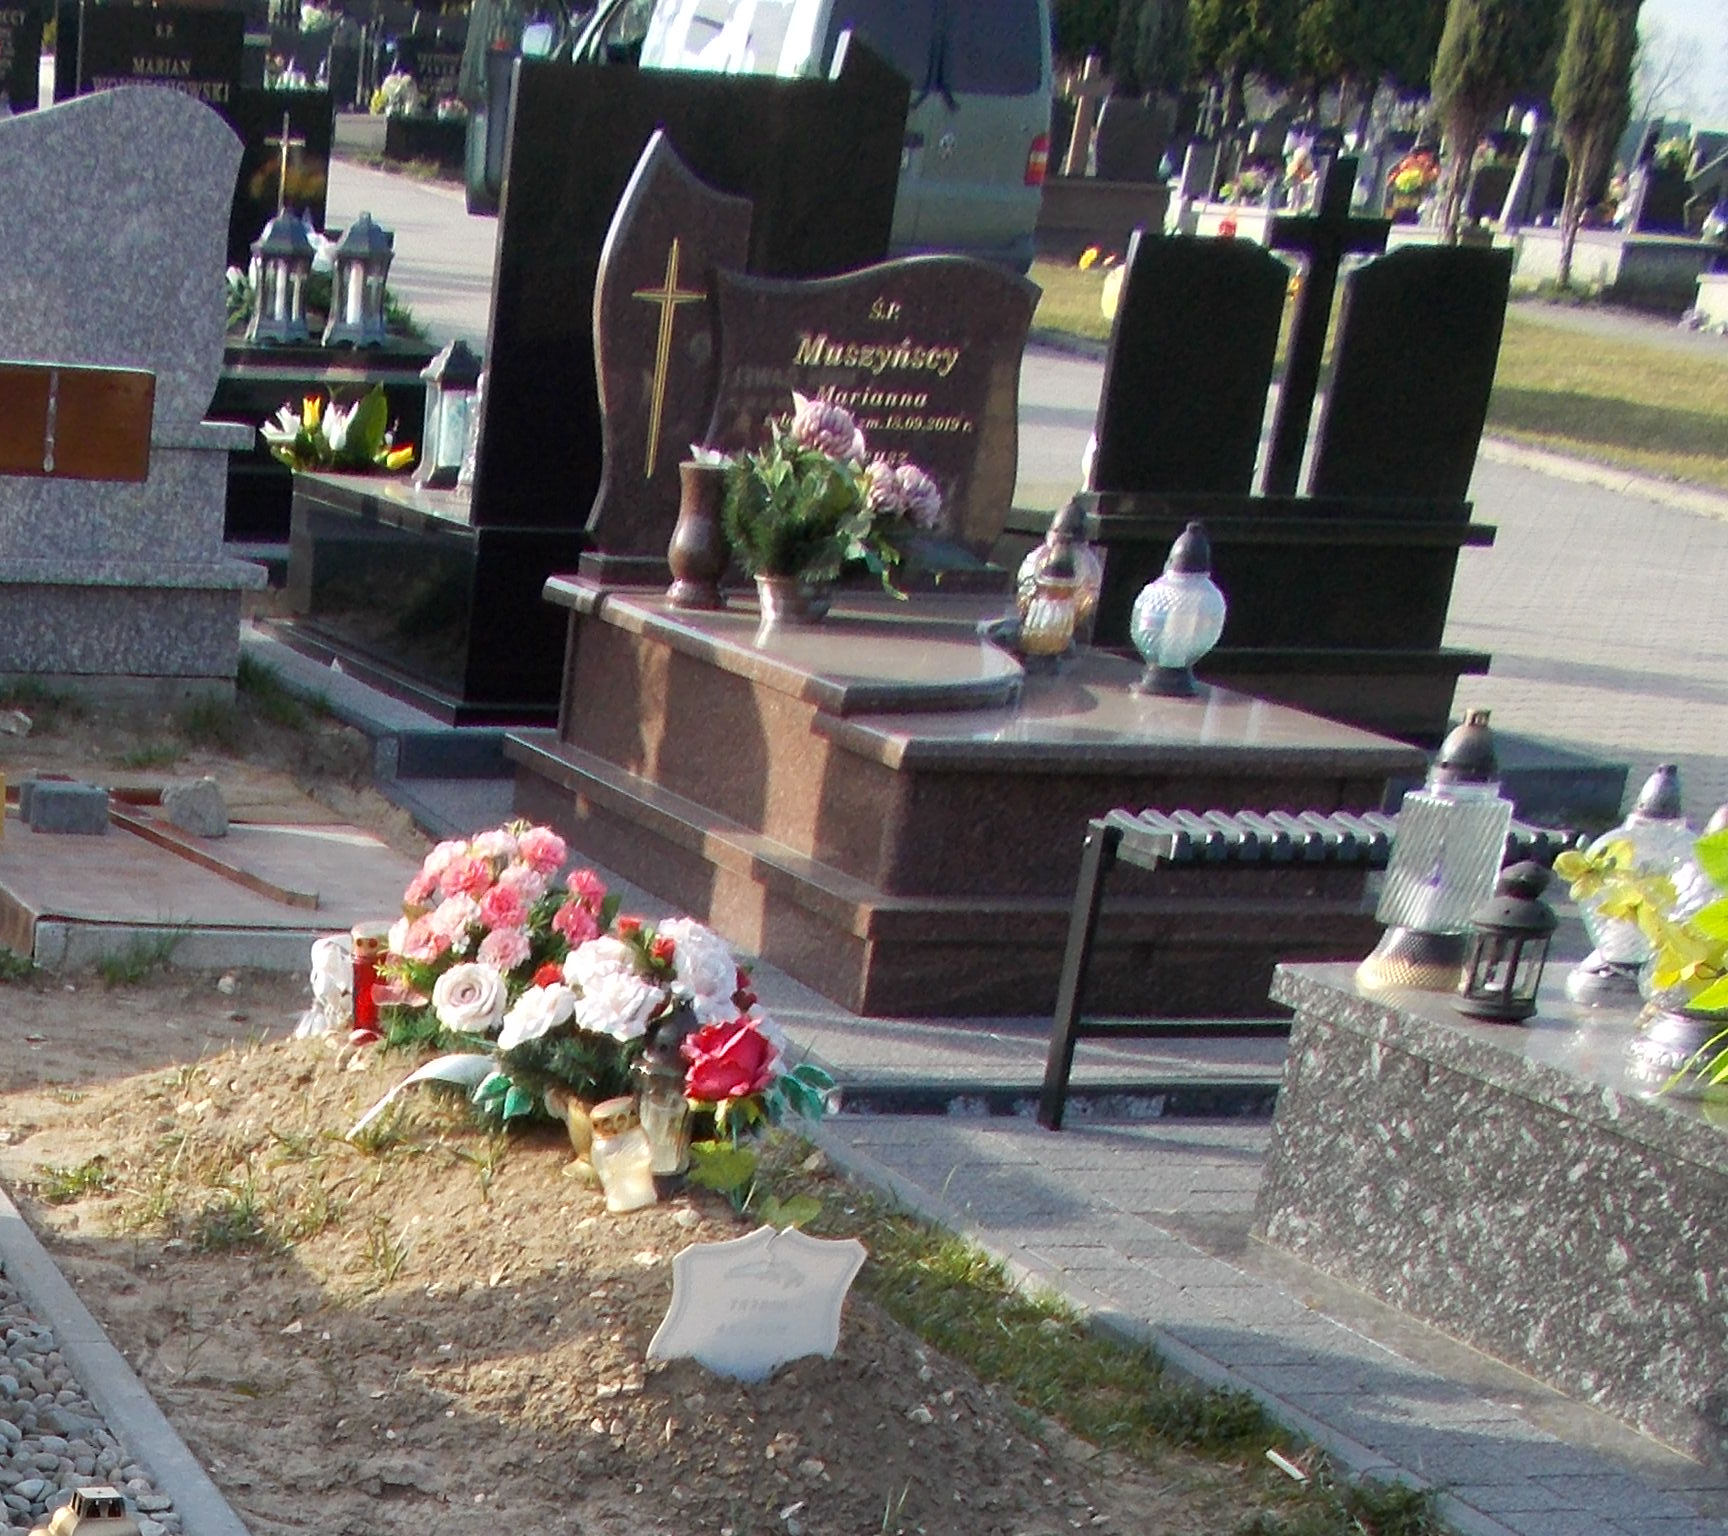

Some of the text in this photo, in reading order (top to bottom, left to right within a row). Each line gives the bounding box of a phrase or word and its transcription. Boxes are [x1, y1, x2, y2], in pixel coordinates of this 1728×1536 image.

[133, 57, 191, 76] MARIAN
[793, 333, 960, 377] Muszyńscy
[818, 385, 928, 408] Marianna
